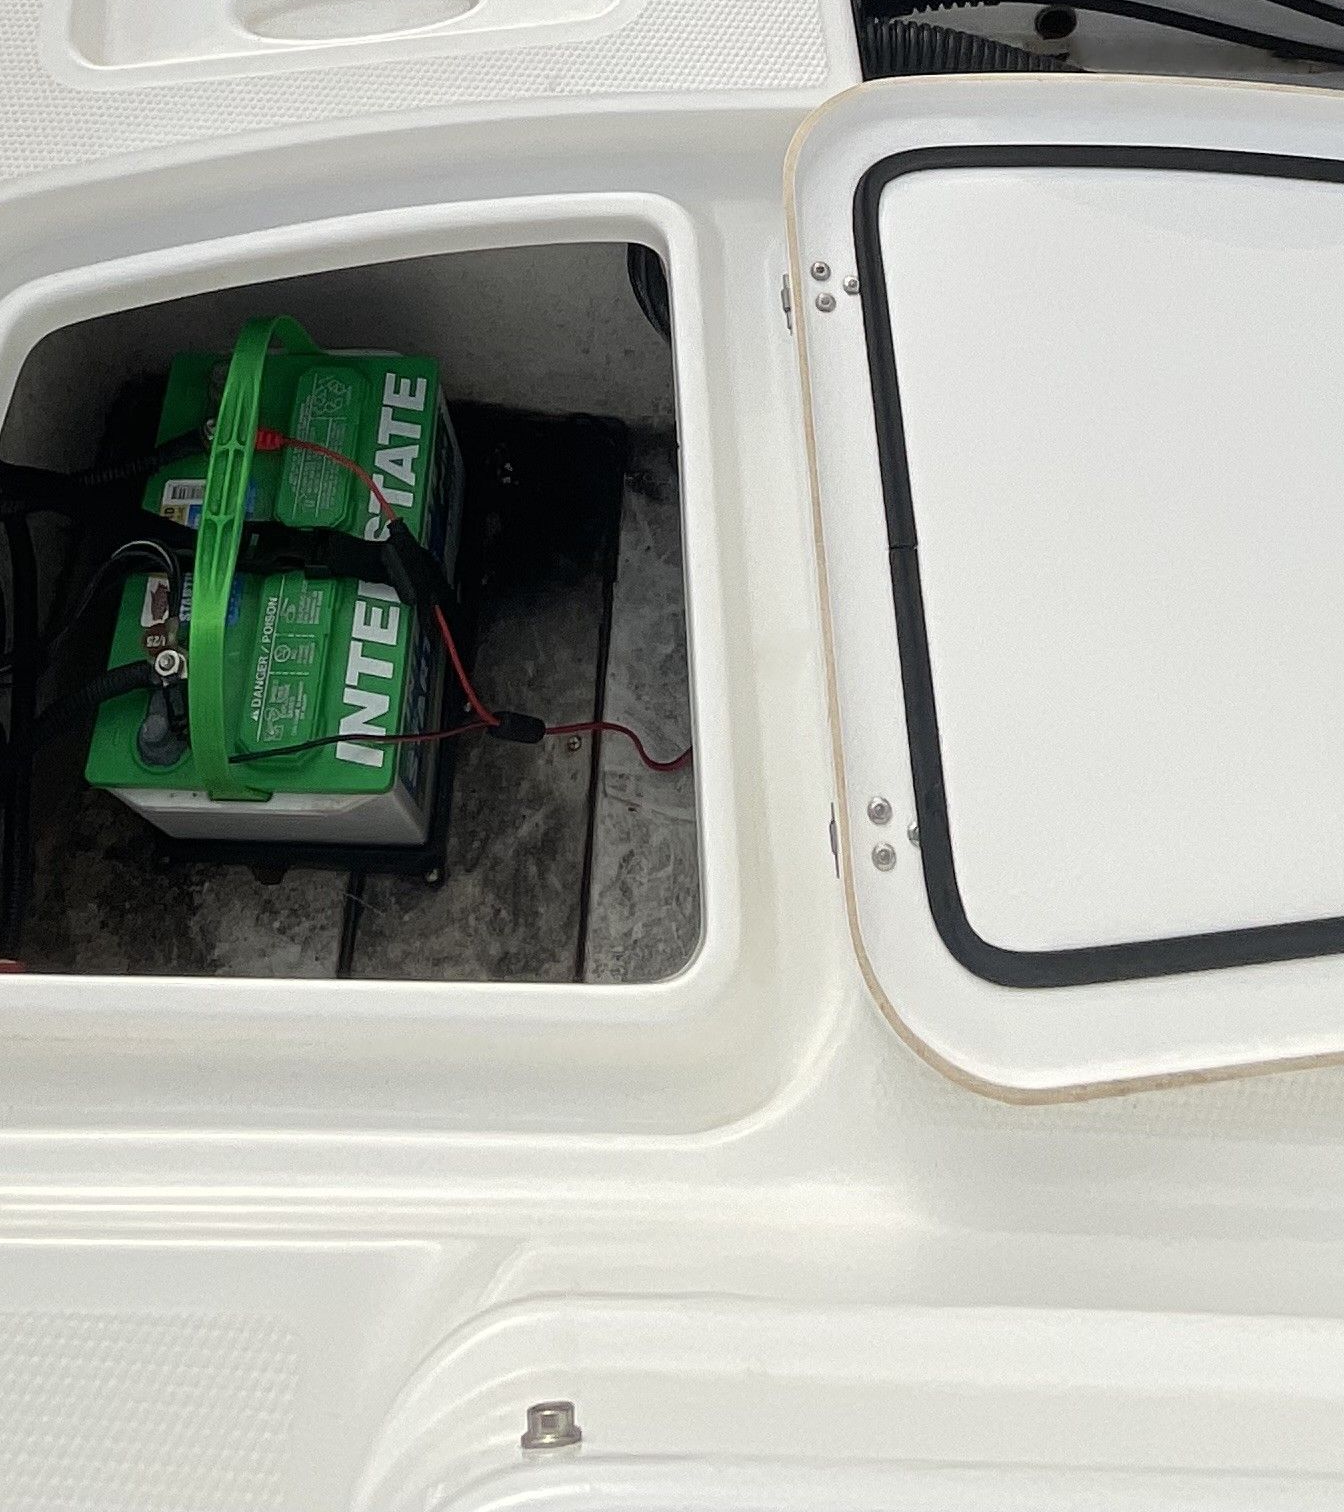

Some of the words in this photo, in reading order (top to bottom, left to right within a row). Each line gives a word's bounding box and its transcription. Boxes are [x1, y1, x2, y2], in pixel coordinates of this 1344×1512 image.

[250, 656, 268, 707] DANGER
[261, 595, 278, 643] POISON
[336, 373, 427, 768] INTETATE
